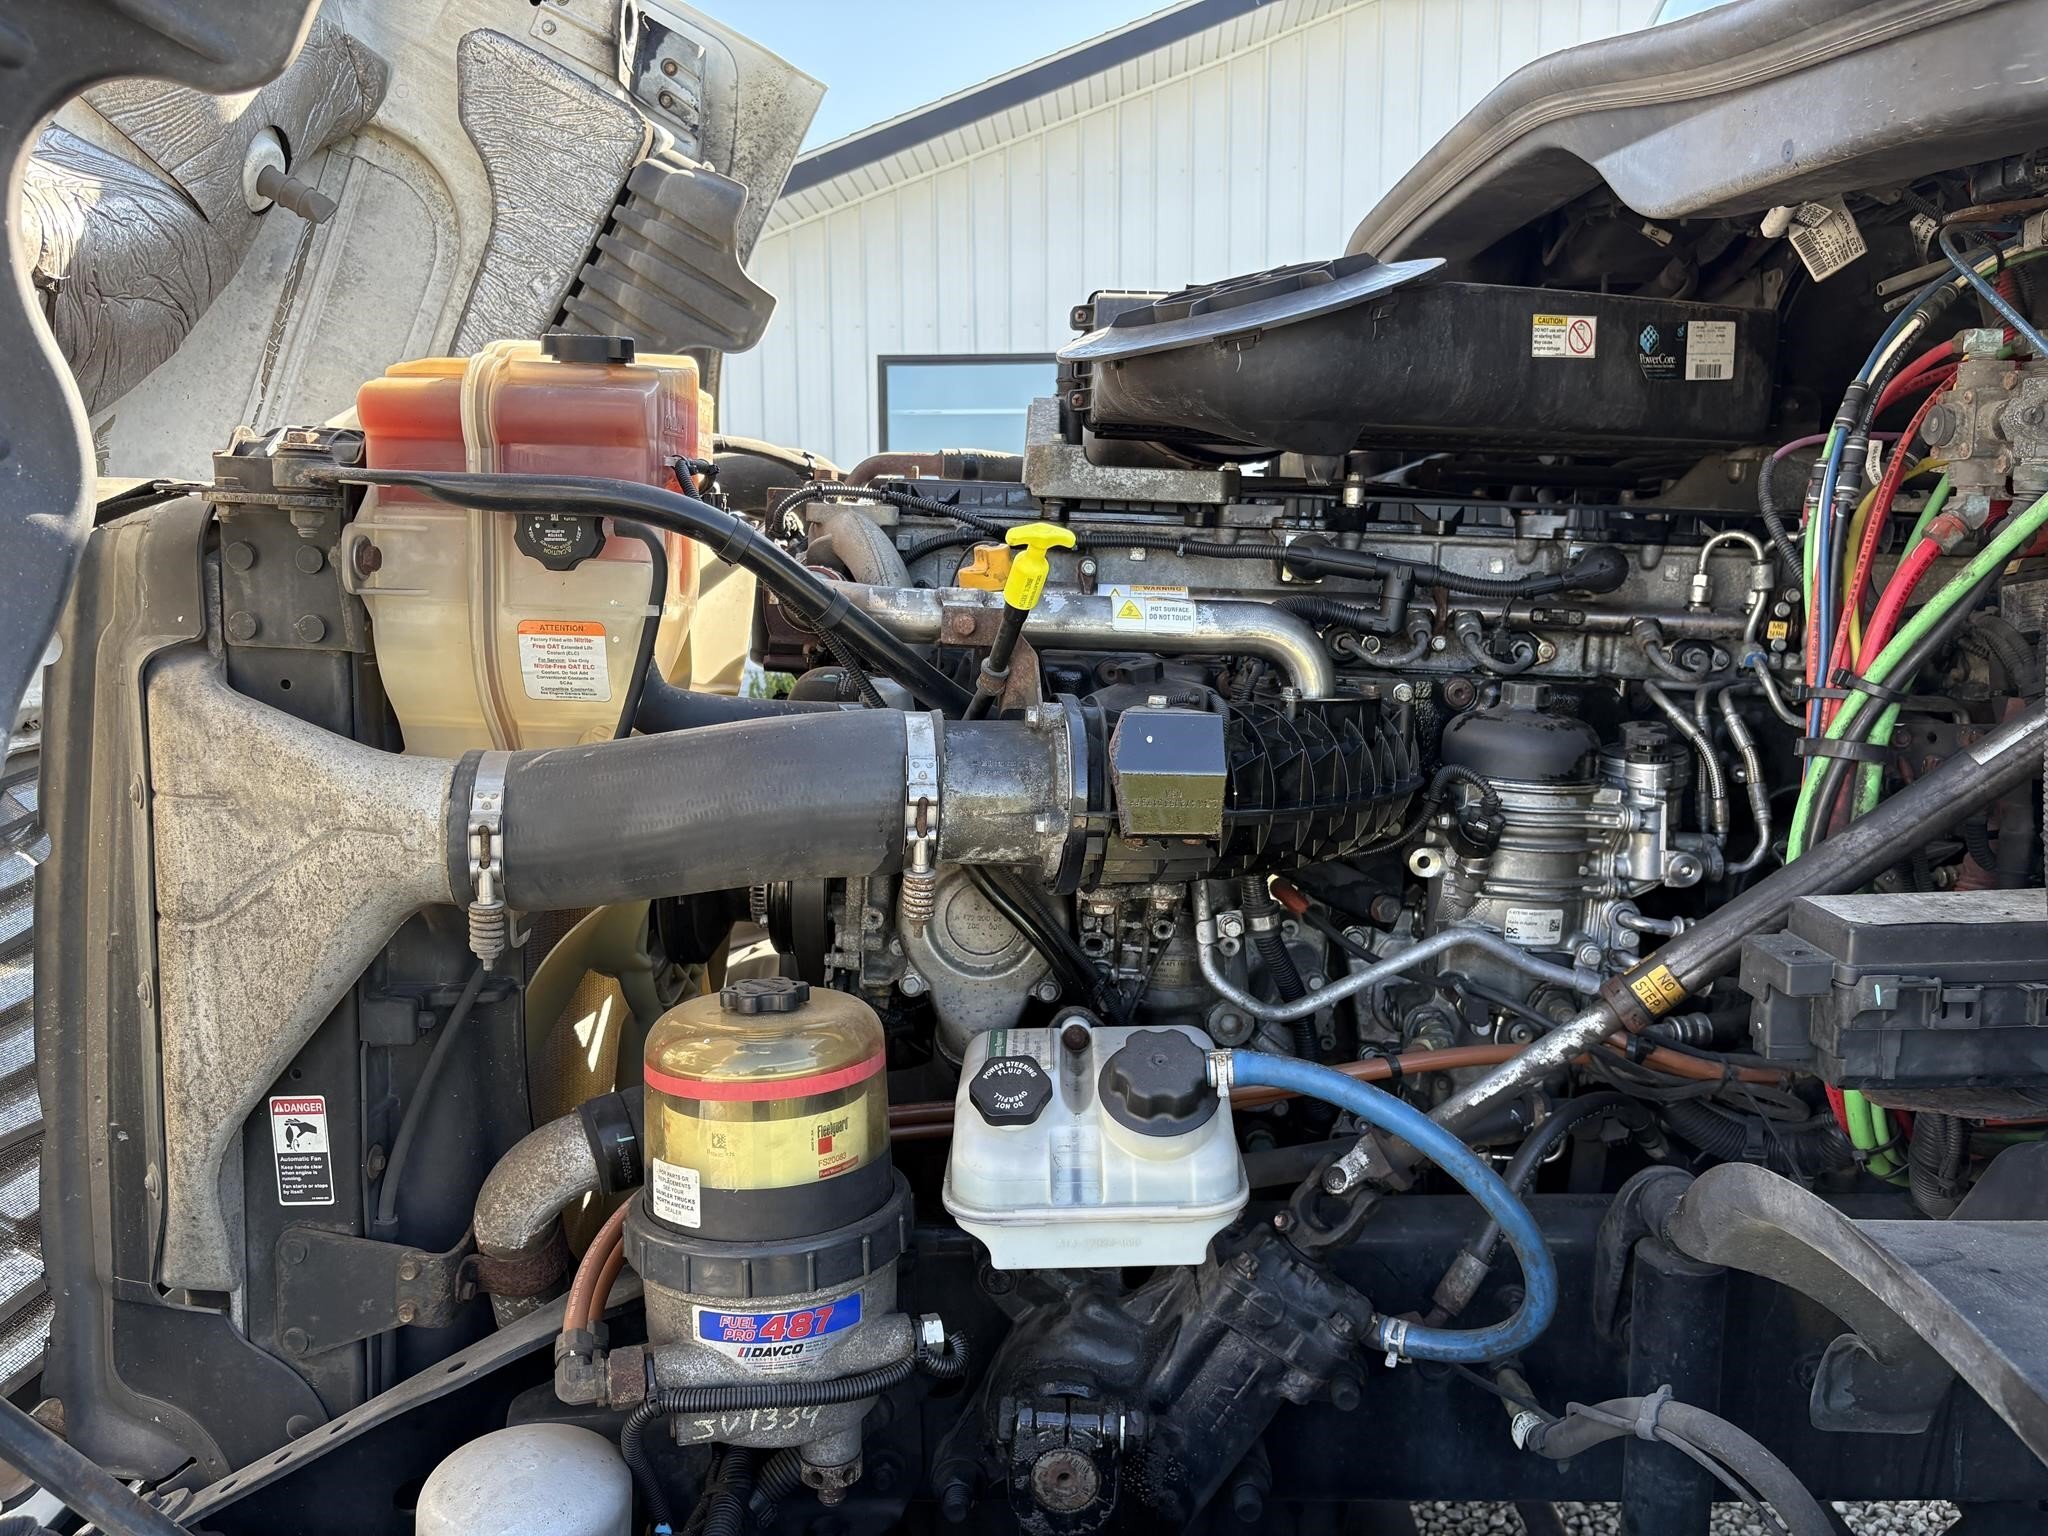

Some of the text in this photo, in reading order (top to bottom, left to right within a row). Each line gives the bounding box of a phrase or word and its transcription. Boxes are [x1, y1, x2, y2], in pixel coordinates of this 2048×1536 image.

[1640, 353, 1676, 365] PowerCore
[1657, 973, 1676, 991] NO
[1635, 981, 1660, 1007] STEP
[983, 1061, 1037, 1080] POWER STEERING
[998, 1068, 1022, 1076] FLUID
[993, 1091, 1028, 1103] OVERFILL
[284, 1103, 322, 1112] DANGER
[1013, 1101, 1024, 1109] DO
[817, 1117, 848, 1138] Fleetguard
[667, 1171, 681, 1180] PARTS
[657, 1196, 694, 1211] NORTH AMERICA
[674, 1196, 695, 1205] TRUCKS
[664, 1205, 681, 1215] DEALER
[719, 1316, 757, 1329] FUEL
[759, 1305, 834, 1342] 487
[724, 1329, 756, 1342] PRO
[751, 1343, 804, 1357] DAVCO
